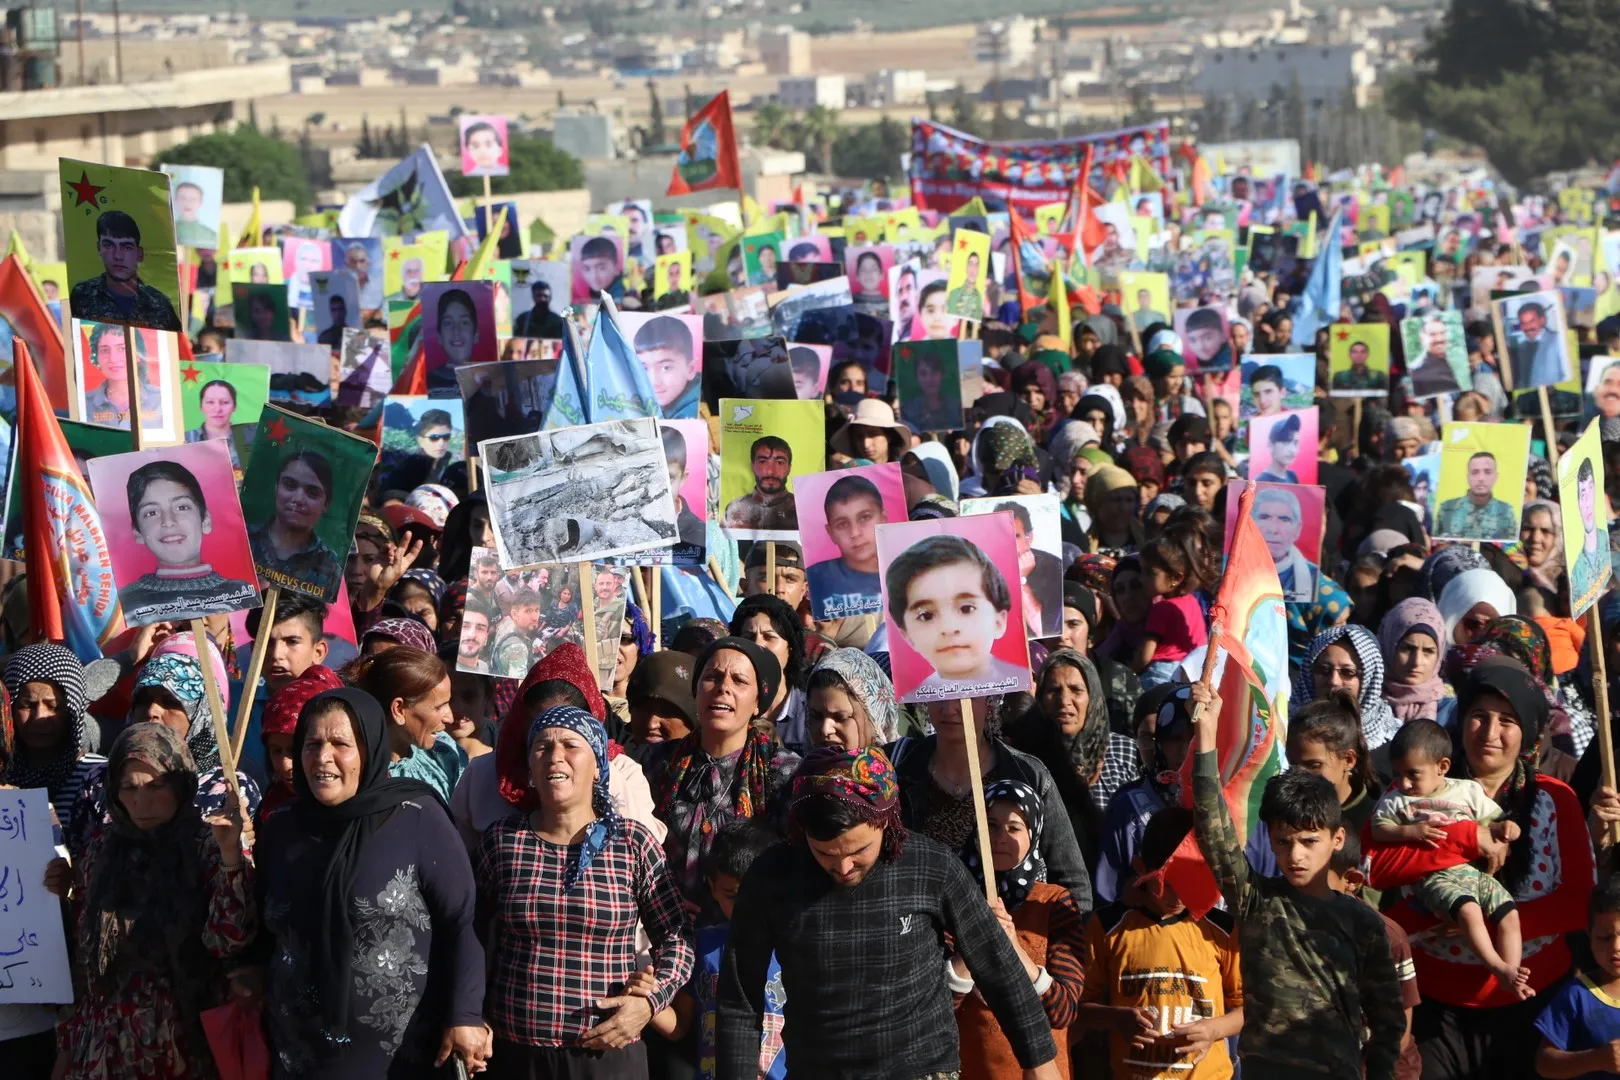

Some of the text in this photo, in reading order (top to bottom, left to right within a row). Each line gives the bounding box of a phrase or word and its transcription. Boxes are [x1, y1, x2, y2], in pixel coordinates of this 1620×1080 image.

[73, 504, 112, 568] MALBATEN
[201, 592, 229, 609] سمير
[227, 584, 256, 604] الشهيد
[158, 596, 185, 616] الرحمن
[186, 598, 201, 611] عبد
[938, 683, 960, 698] الفتاح
[959, 685, 973, 695] عبد
[990, 676, 1019, 691] الشهيد
